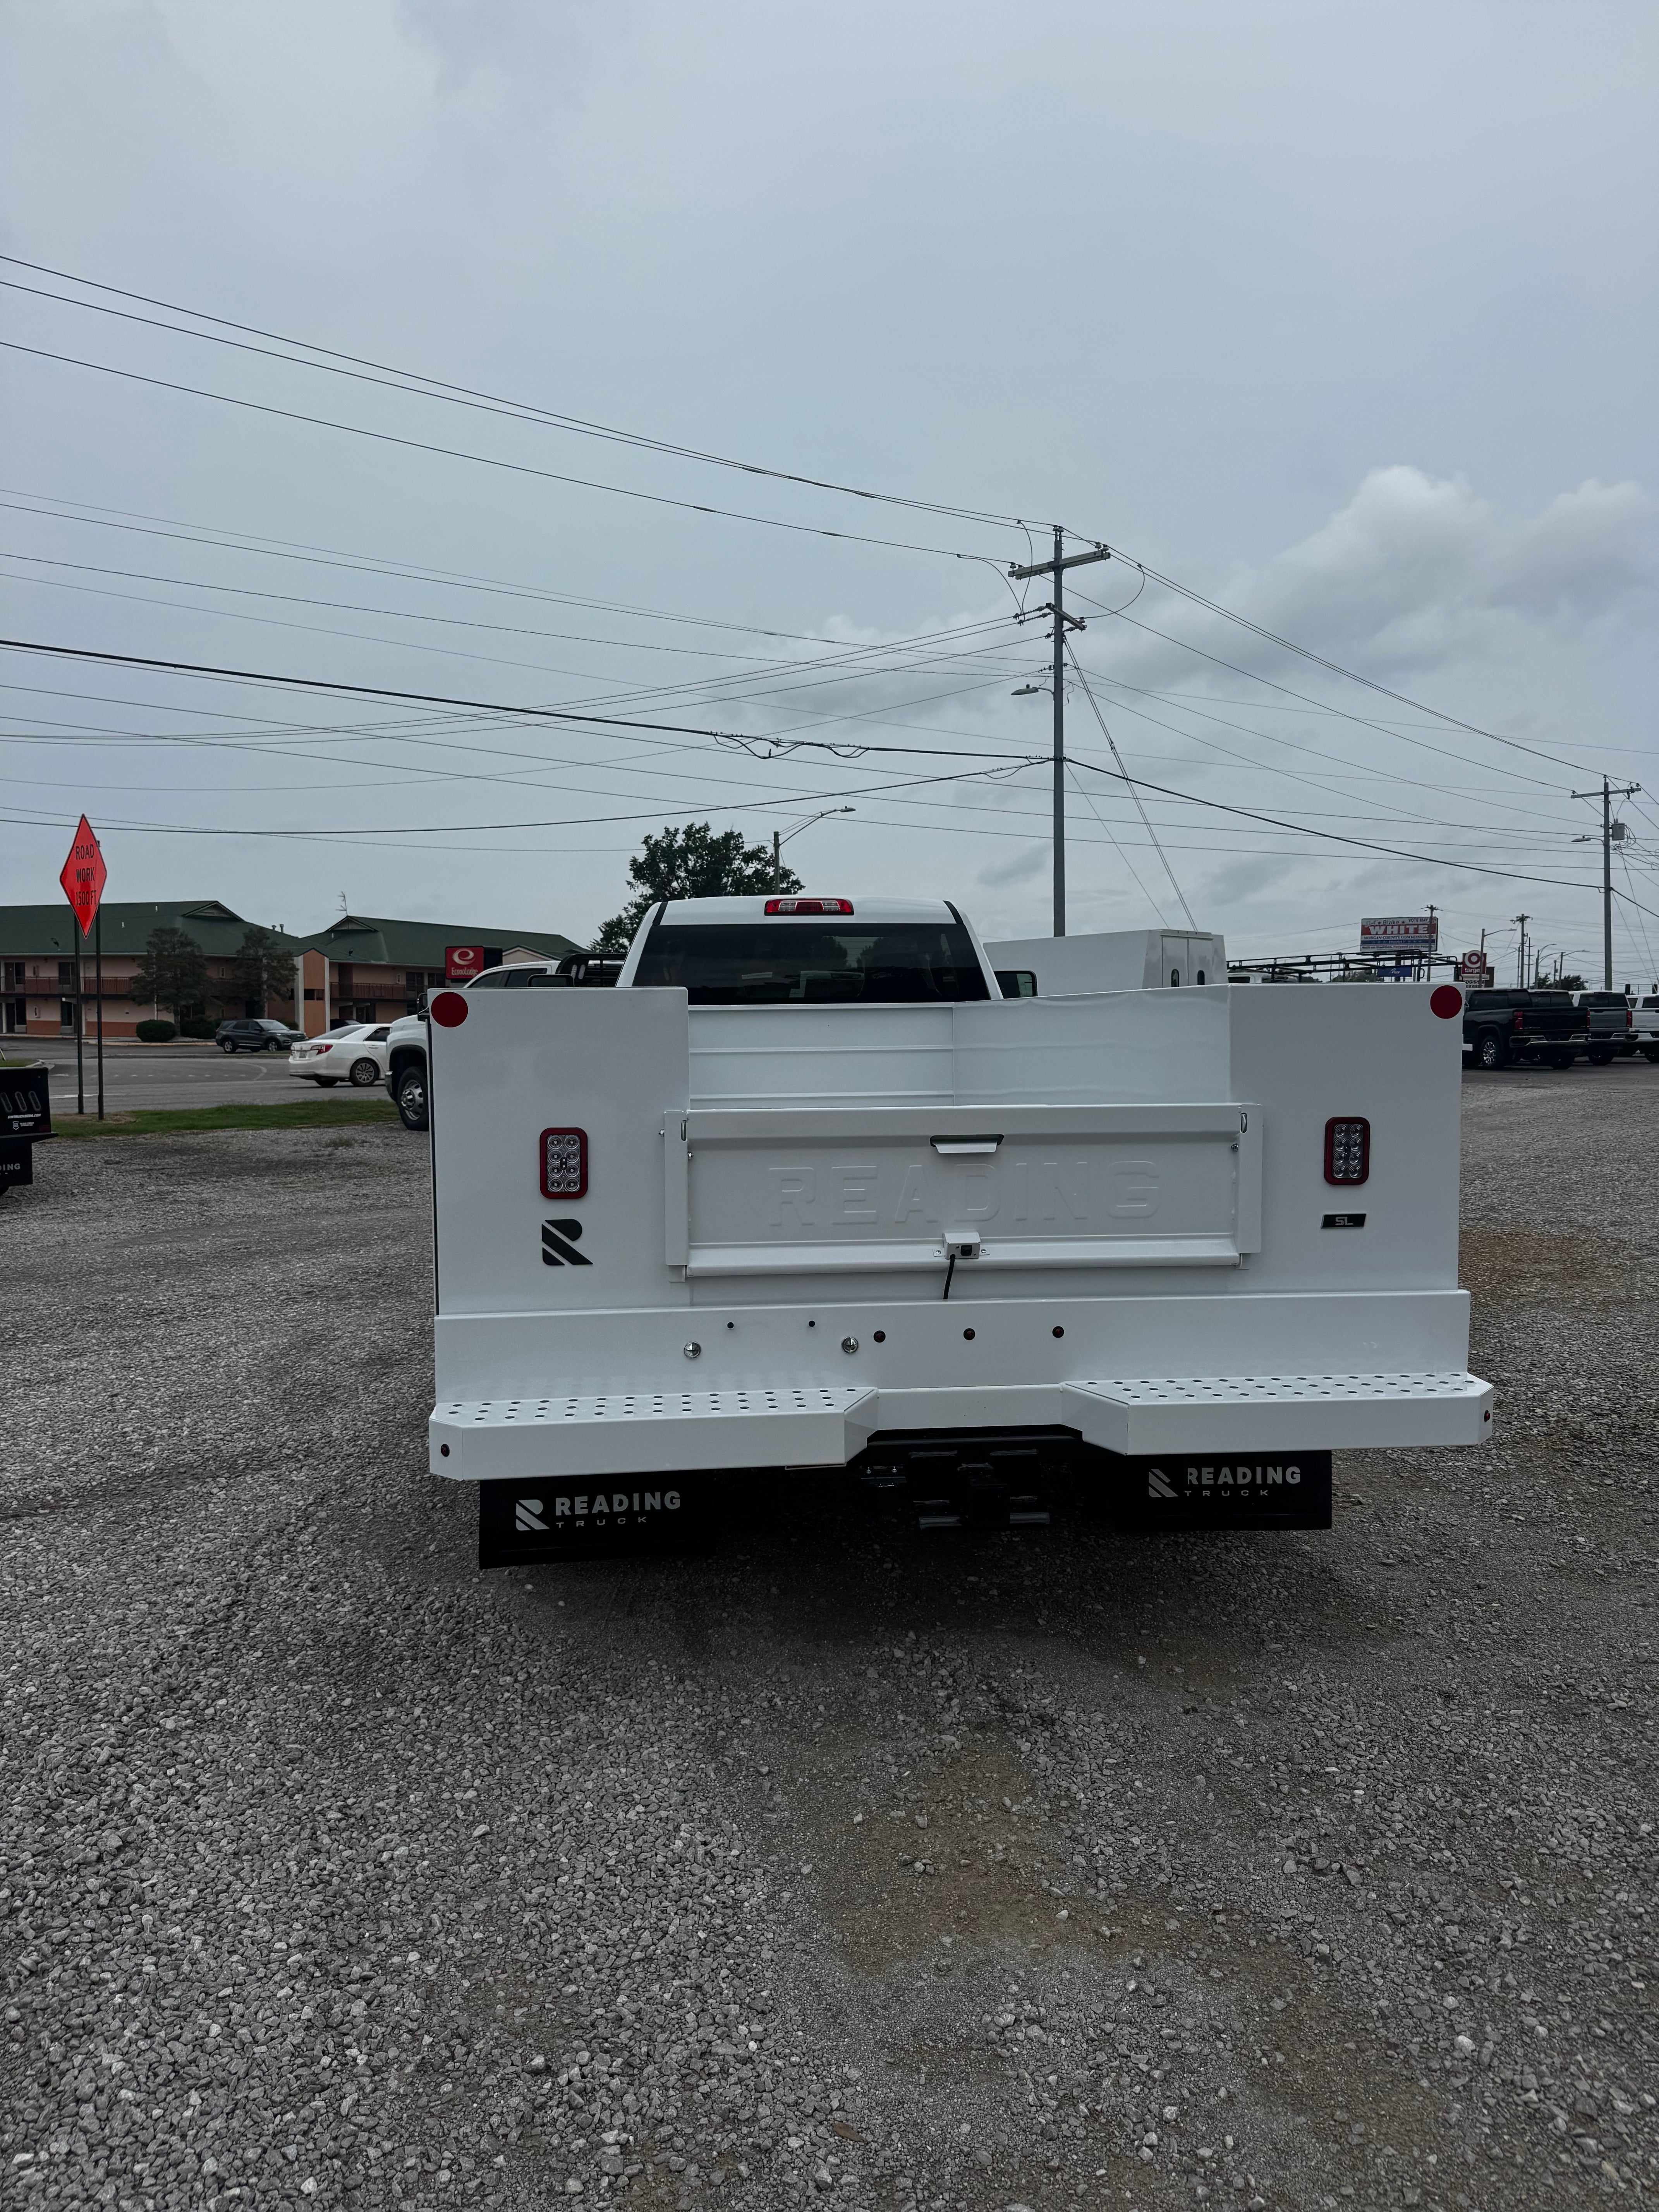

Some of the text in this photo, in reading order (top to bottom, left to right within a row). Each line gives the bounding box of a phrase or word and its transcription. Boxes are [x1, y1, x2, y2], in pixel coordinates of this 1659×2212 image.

[76, 844, 94, 860] ROAD
[76, 867, 95, 883] WORK
[76, 890, 96, 906] 1500 FT
[1369, 925, 1428, 934] WHITE
[768, 1160, 1160, 1226] READING
[1335, 1216, 1353, 1225] SL
[1187, 1466, 1301, 1484] READING
[555, 1491, 681, 1516] READING
[556, 1516, 647, 1528] TRUCK
